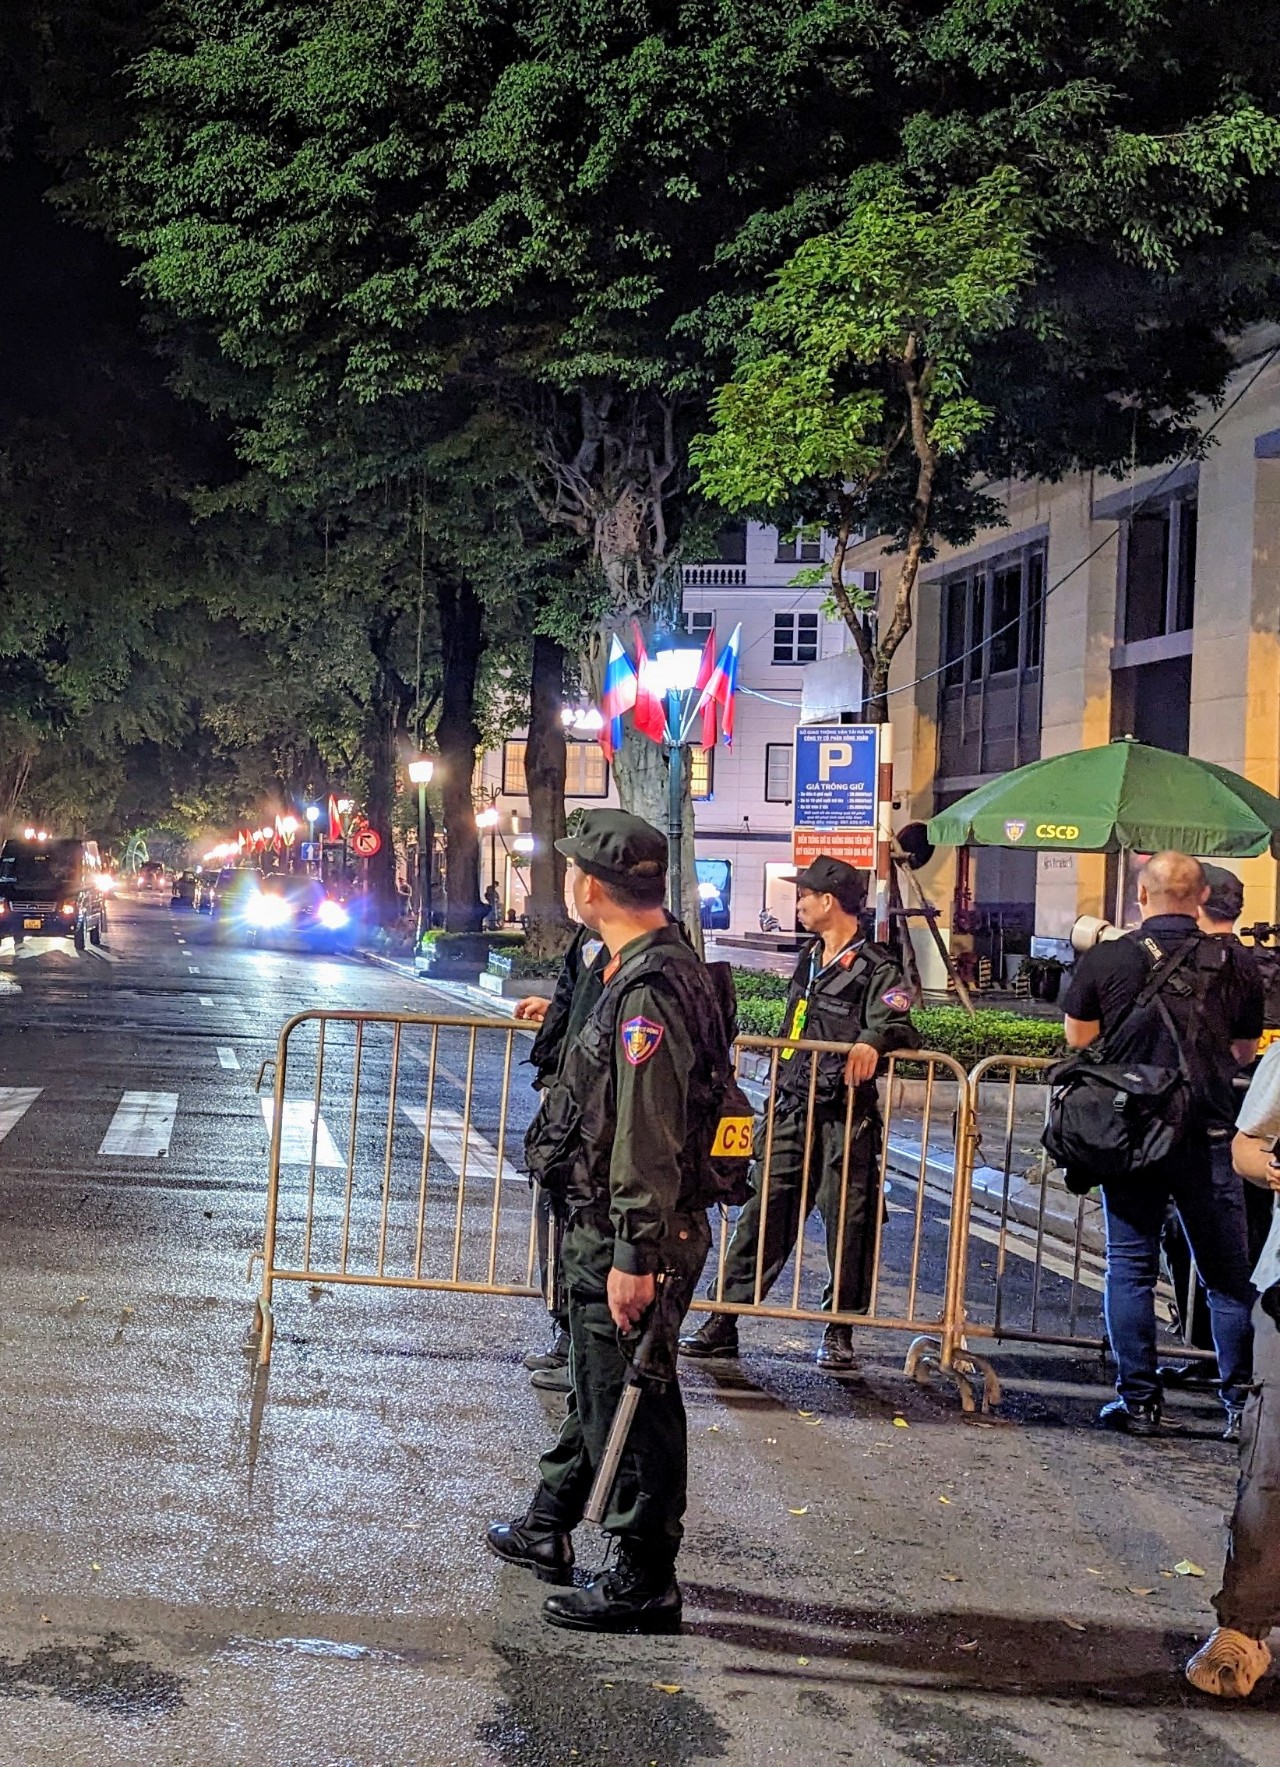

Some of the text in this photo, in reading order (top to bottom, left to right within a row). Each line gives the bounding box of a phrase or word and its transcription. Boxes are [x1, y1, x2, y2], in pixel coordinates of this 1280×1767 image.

[819, 743, 853, 781] P
[1036, 825, 1079, 839] CSCĐ
[723, 1124, 753, 1150] CS
